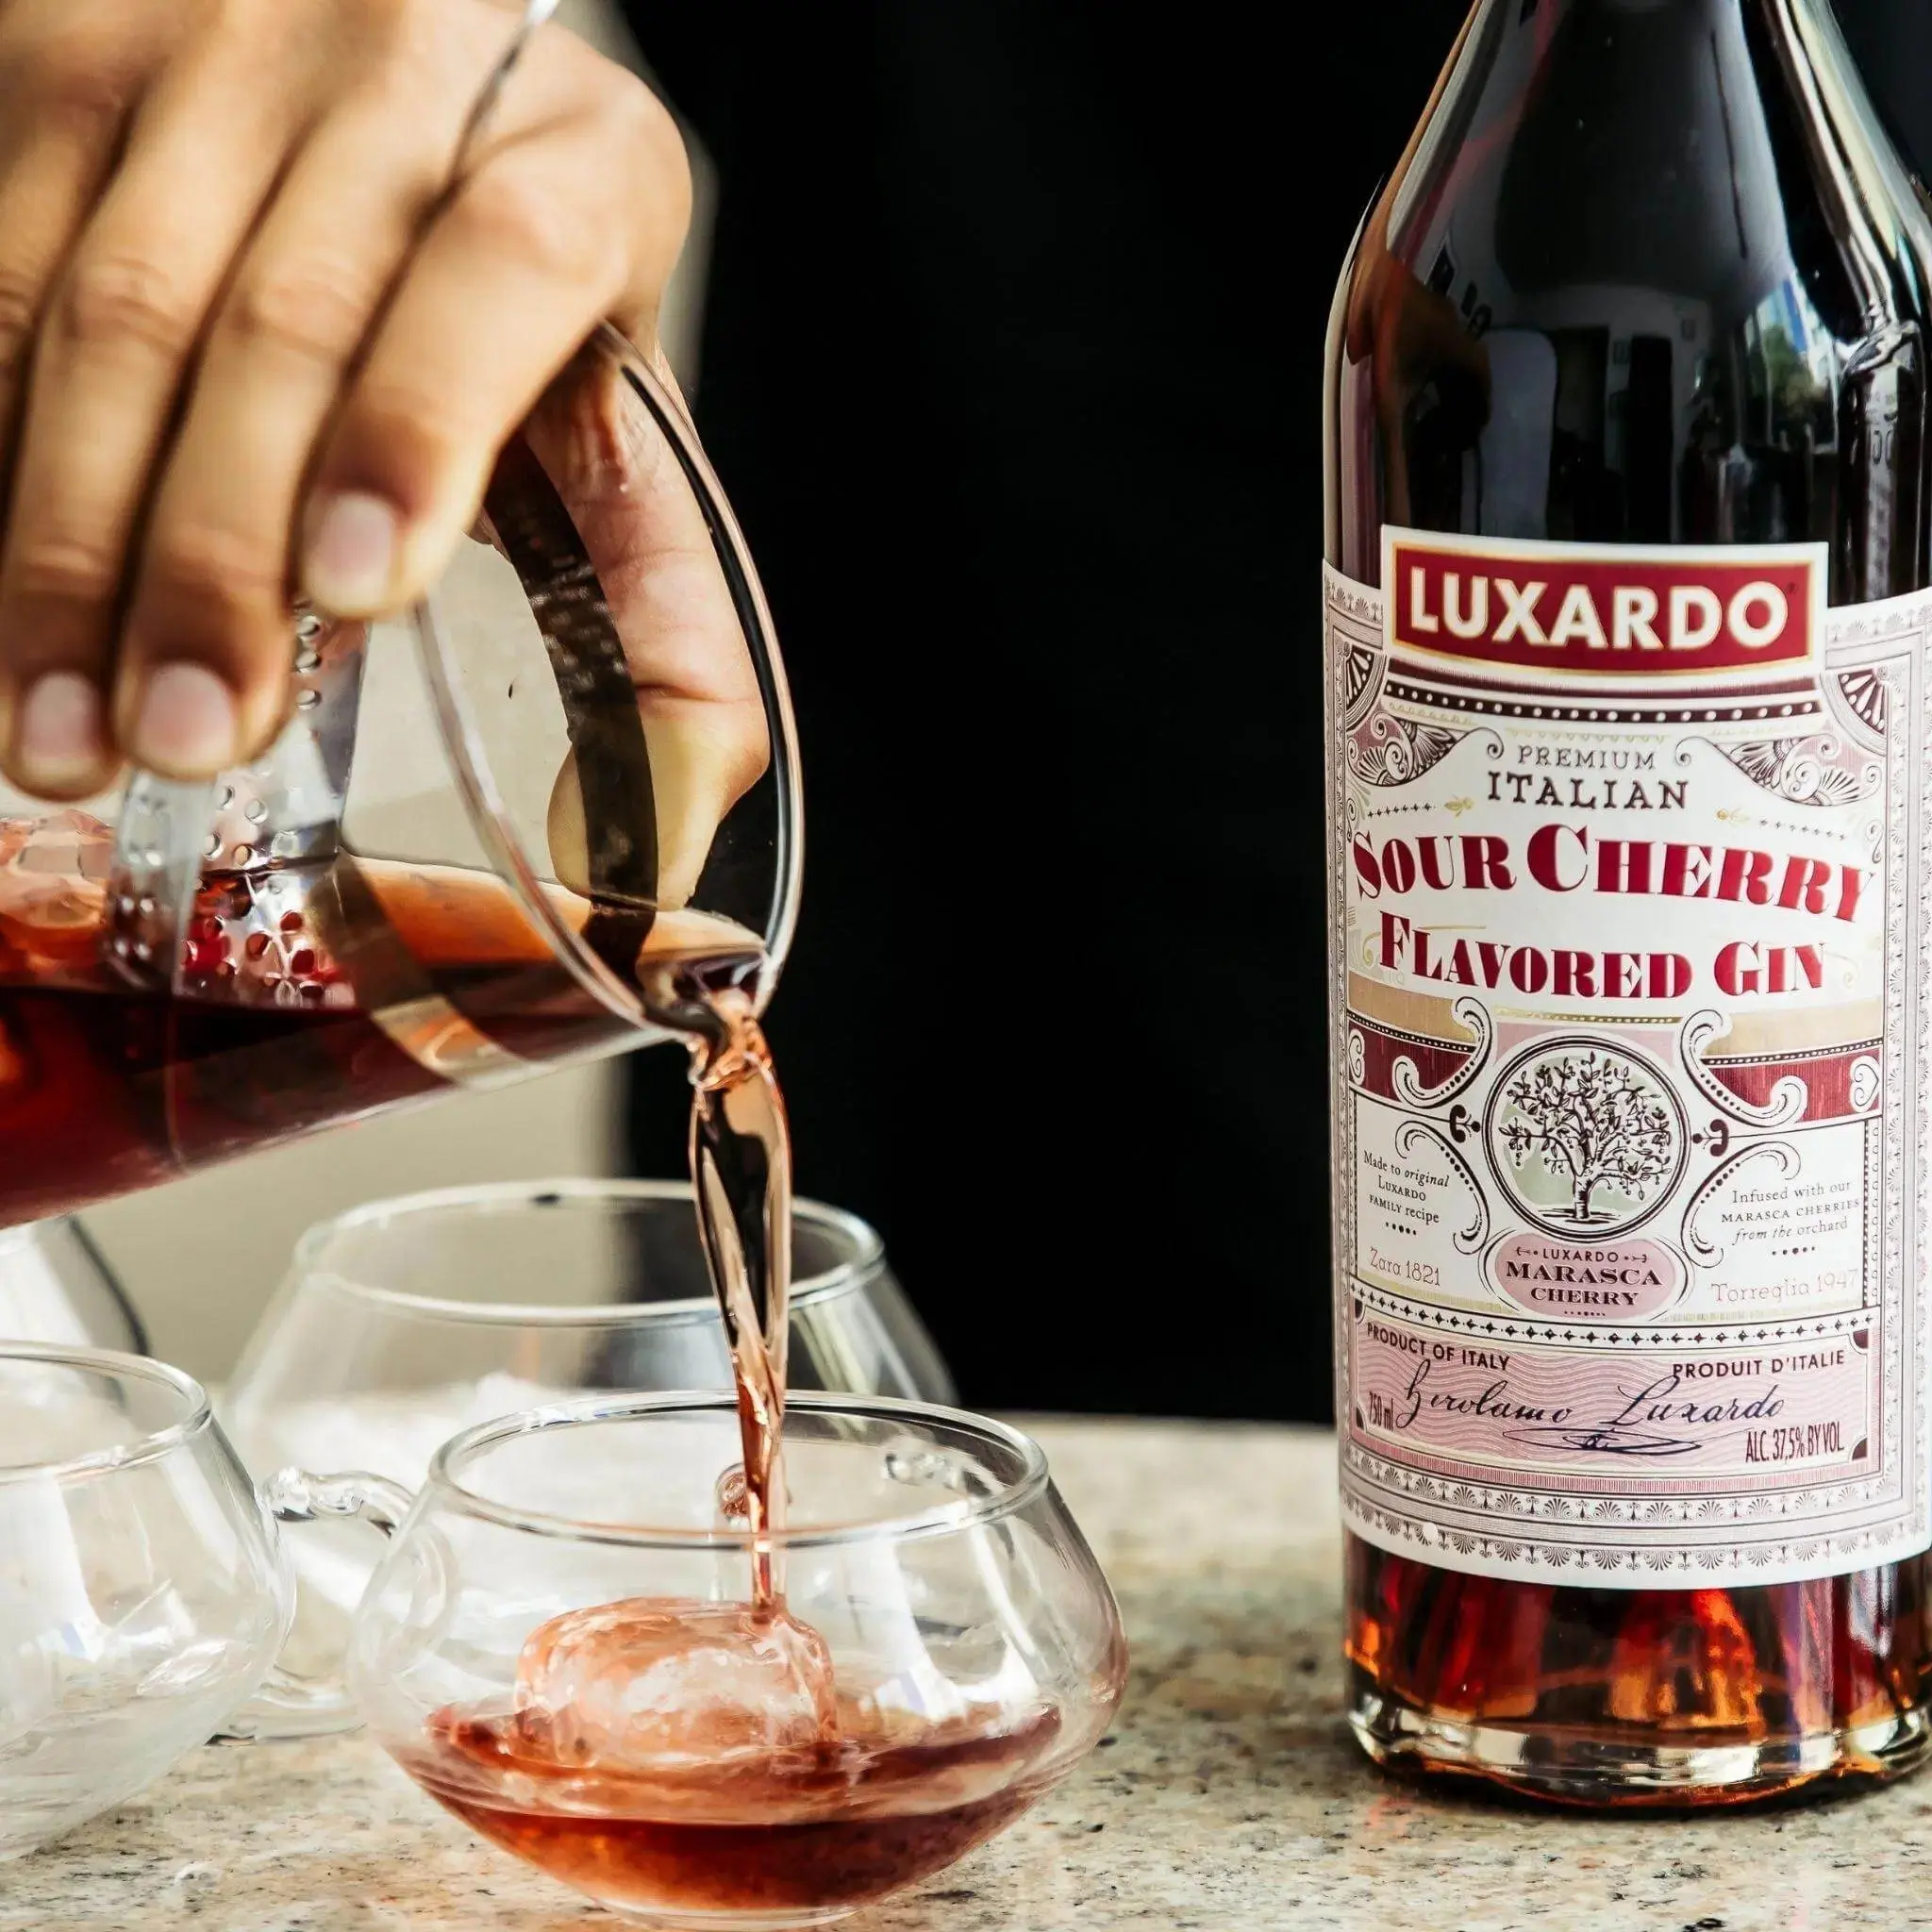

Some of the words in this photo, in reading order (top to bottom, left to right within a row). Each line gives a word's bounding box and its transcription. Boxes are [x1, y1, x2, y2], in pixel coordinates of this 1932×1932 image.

[1411, 566, 1789, 650] LUXARDO
[1518, 744, 1656, 770] PREMIUM
[1488, 770, 1689, 809] ITALIAN
[1353, 830, 1518, 900] SOUR
[1527, 824, 1877, 924] CHERRY
[1379, 910, 1693, 999] FLAVORED
[1714, 941, 1825, 997] GIN
[1363, 1150, 1388, 1171] Made
[1391, 1164, 1401, 1175] to
[1404, 1170, 1449, 1187] original
[1378, 1174, 1426, 1201] LUXARDO
[1732, 1187, 1788, 1204] Infused
[1793, 1182, 1824, 1198] with
[1830, 1180, 1851, 1192] our
[1369, 1194, 1403, 1213] FAMILY
[1405, 1207, 1440, 1224] recipe
[1721, 1209, 1790, 1223] MARASCA
[1796, 1198, 1860, 1216] CHERRIES
[1732, 1227, 1767, 1245] from
[1773, 1224, 1791, 1239] the
[1797, 1216, 1848, 1236] orchard
[1370, 1245, 1401, 1275] Zara
[1406, 1259, 1441, 1287] 1821
[1506, 1260, 1663, 1286] MARASCA
[1542, 1248, 1619, 1263] LUXARDO
[1530, 1287, 1639, 1306] CHERRY
[1710, 1277, 1809, 1303] Torreglia
[1818, 1268, 1859, 1292] 1947
[1367, 1322, 1427, 1356] PRODUCT
[1433, 1343, 1455, 1361] OF
[1462, 1350, 1509, 1371] ITALY
[1673, 1359, 1762, 1379] PRODUIT
[1772, 1349, 1845, 1374] D'ITALIE
[1369, 1391, 1383, 1427] 750
[1383, 1397, 1394, 1432] ml
[1599, 1374, 1785, 1426] Luxardo
[1745, 1430, 1770, 1463] ALC.
[1773, 1426, 1805, 1463] 37,5%
[1807, 1424, 1822, 1457] BY
